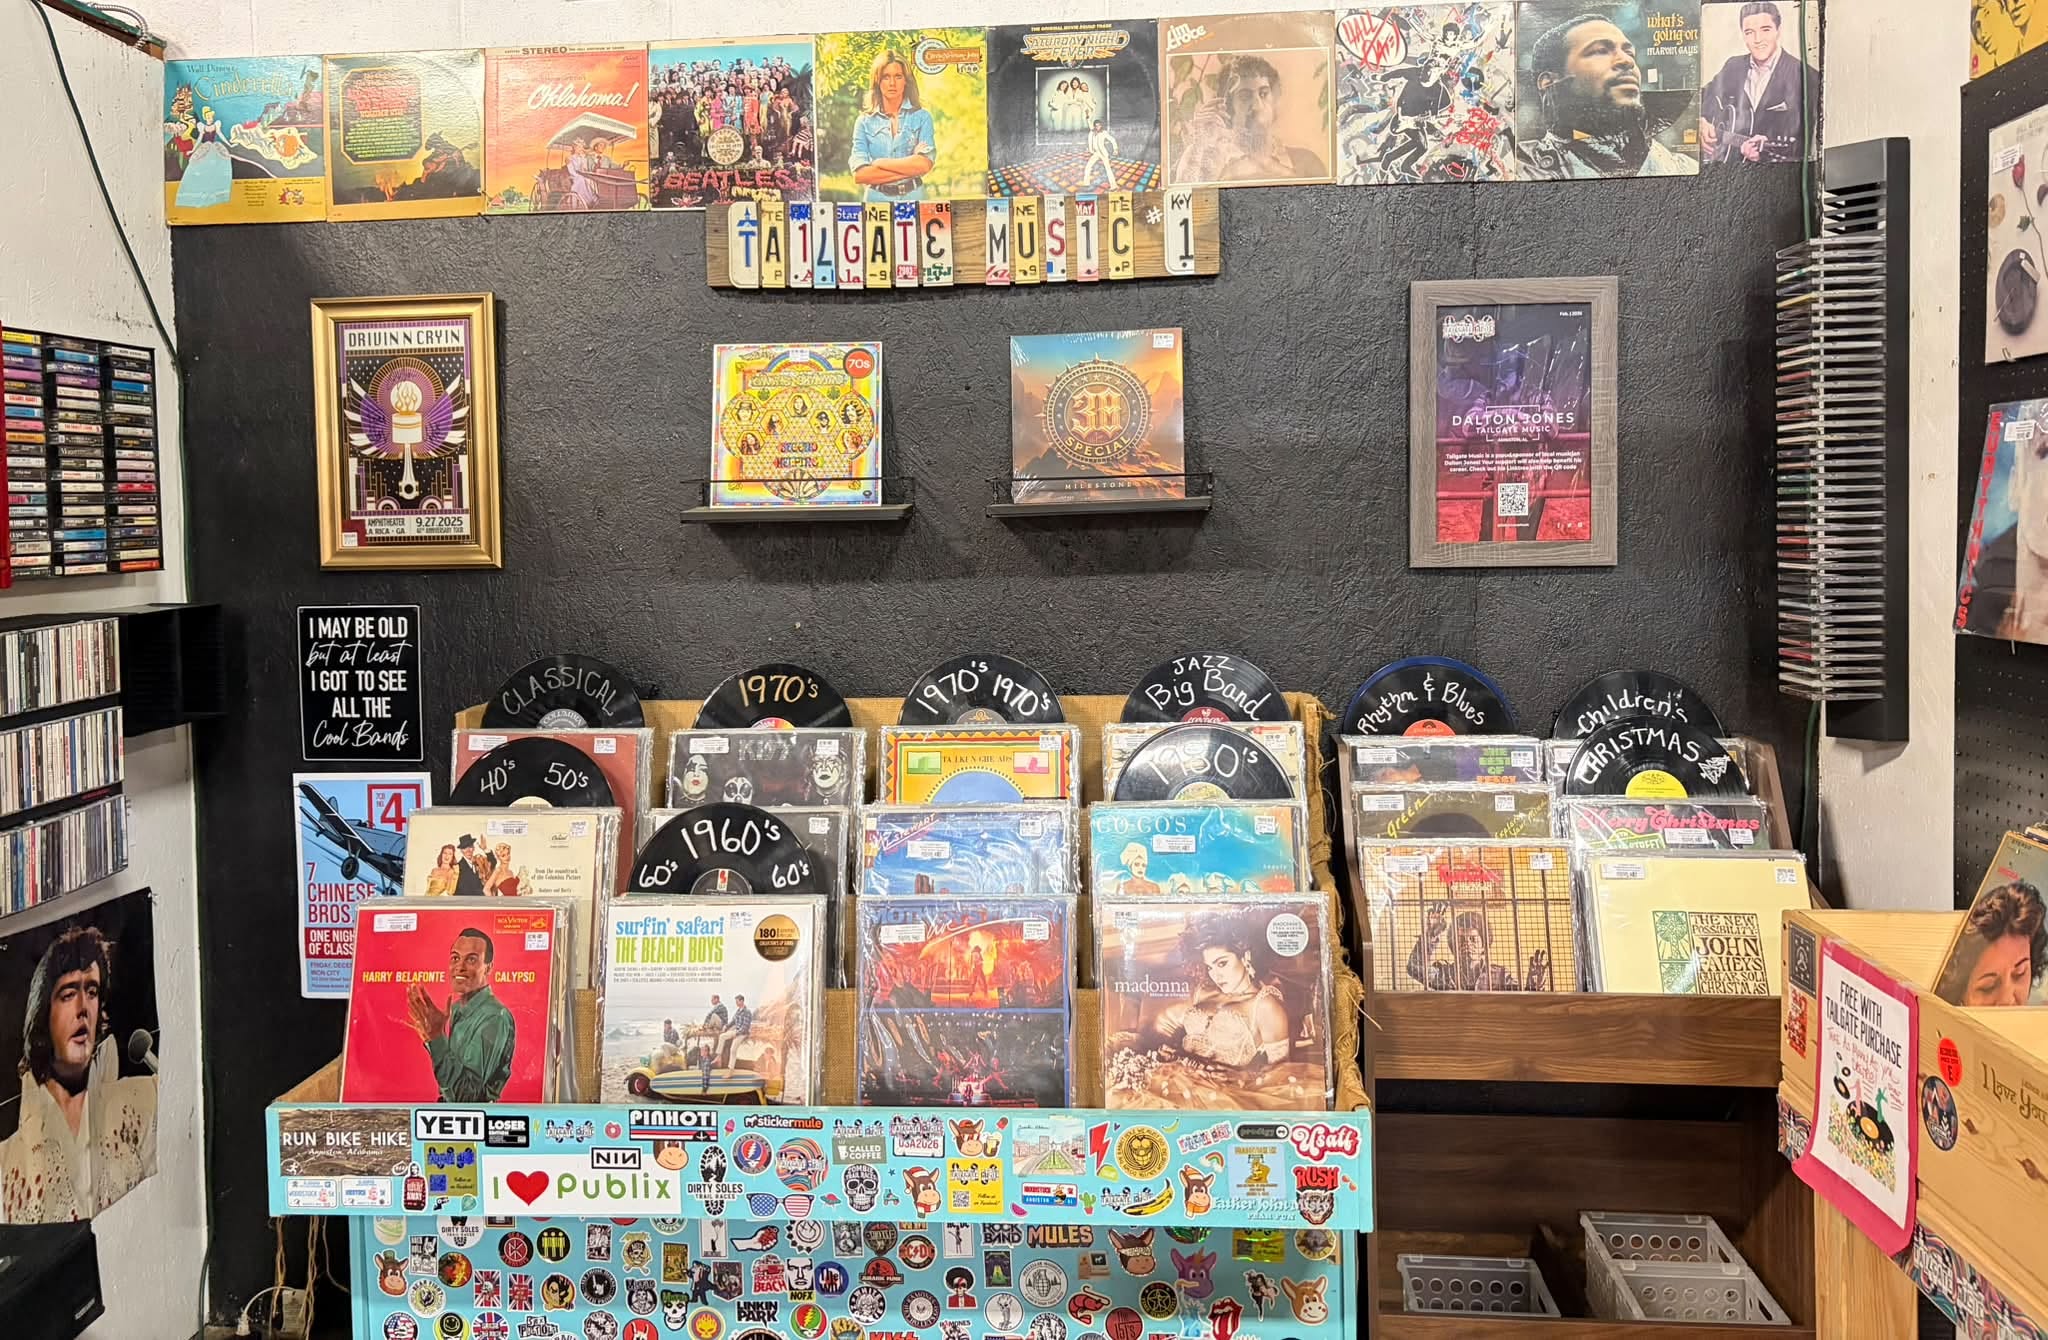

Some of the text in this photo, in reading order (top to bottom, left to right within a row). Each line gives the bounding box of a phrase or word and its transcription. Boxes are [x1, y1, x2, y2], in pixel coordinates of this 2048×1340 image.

[1647, 11, 1684, 28] what's
[1026, 32, 1122, 48] SATURDAY NIGHT
[1653, 27, 1698, 46] going on
[521, 46, 568, 56] STEREO
[1051, 46, 1096, 58] FEVER
[193, 72, 294, 101] Cinderella
[528, 81, 640, 109] Oklahoma!
[664, 169, 794, 192] BEATLES
[403, 328, 461, 346] N CRYIN
[848, 358, 871, 369] 70s
[1071, 386, 1123, 439] 38
[1452, 412, 1575, 427] DALTON JONES
[1475, 425, 1551, 435] TAILGATE MUSIC
[1064, 435, 1131, 457] SPECIAL
[367, 516, 464, 527] AMPHITHEATER 9.27.2025
[1957, 411, 2003, 628] EURYTHMICS
[309, 616, 408, 639] I MAY BE OLD
[305, 640, 413, 667] but at least
[1172, 653, 1235, 676] JAZZ
[311, 670, 407, 692] I GOT TO SEE
[916, 661, 1051, 717] 1970's 1970's
[502, 666, 617, 717] CLASSICAL
[738, 674, 820, 708] 1970's
[1144, 667, 1272, 722] Big Band
[331, 696, 392, 718] ALL THE
[1357, 692, 1418, 735] Rhythm
[1441, 681, 1485, 726] Blues
[1577, 688, 1688, 736] Children's
[312, 719, 409, 751] Cool Bands
[1148, 739, 1259, 785] 1980's
[1574, 727, 1702, 784] CHRISTMAS
[480, 759, 589, 796] 40's 50's
[1487, 766, 1504, 774] OF
[380, 792, 407, 832] 4
[1644, 806, 1760, 831] Christmas
[680, 818, 781, 860] 1960's
[306, 862, 317, 881] 7
[639, 858, 810, 889] 60's 60's
[307, 882, 377, 904] CHINESE
[308, 903, 355, 924] BROS.
[1690, 914, 1756, 927] THE NEW
[615, 915, 725, 936] surfin' safari
[759, 928, 777, 939] 180
[1691, 924, 1758, 936] POSSIBILITY:
[310, 930, 331, 943] ONE
[309, 942, 323, 956] OF
[615, 936, 725, 964] THE BEACH BOYS
[1696, 937, 1760, 957] JOHN
[1699, 956, 1763, 973] FAHEY'S
[362, 971, 536, 983] HARRY BELAFONTE CALYPSO
[1114, 974, 1190, 993] madonna
[1700, 970, 1740, 982] GUITAR
[1700, 981, 1767, 995] CHRISTMAS
[1840, 980, 1883, 1028] FREE WITH
[1825, 996, 1903, 1070] TAILGATE PURCHASE
[420, 1115, 480, 1135] YETI
[488, 1120, 526, 1131] LOSER
[629, 1110, 717, 1127] PINHOTI
[757, 1114, 822, 1128] stickermule
[282, 1131, 408, 1146] RUN BIKE HIKE
[1240, 1127, 1275, 1137] prodigy
[849, 1145, 881, 1153] CALLED
[493, 1172, 671, 1200] I Publix
[687, 1183, 743, 1193] DIRTY SOLES
[1295, 1167, 1340, 1191] RUSH
[657, 1222, 681, 1232] COFFEE
[982, 1223, 1019, 1232] ROCK
[1027, 1225, 1094, 1248] MULES
[982, 1232, 1021, 1244] BAND
[753, 1281, 788, 1293] BEACH
[790, 1291, 813, 1300] NOFX
[737, 1301, 778, 1311] LINKIN
[737, 1309, 778, 1323] PARK
